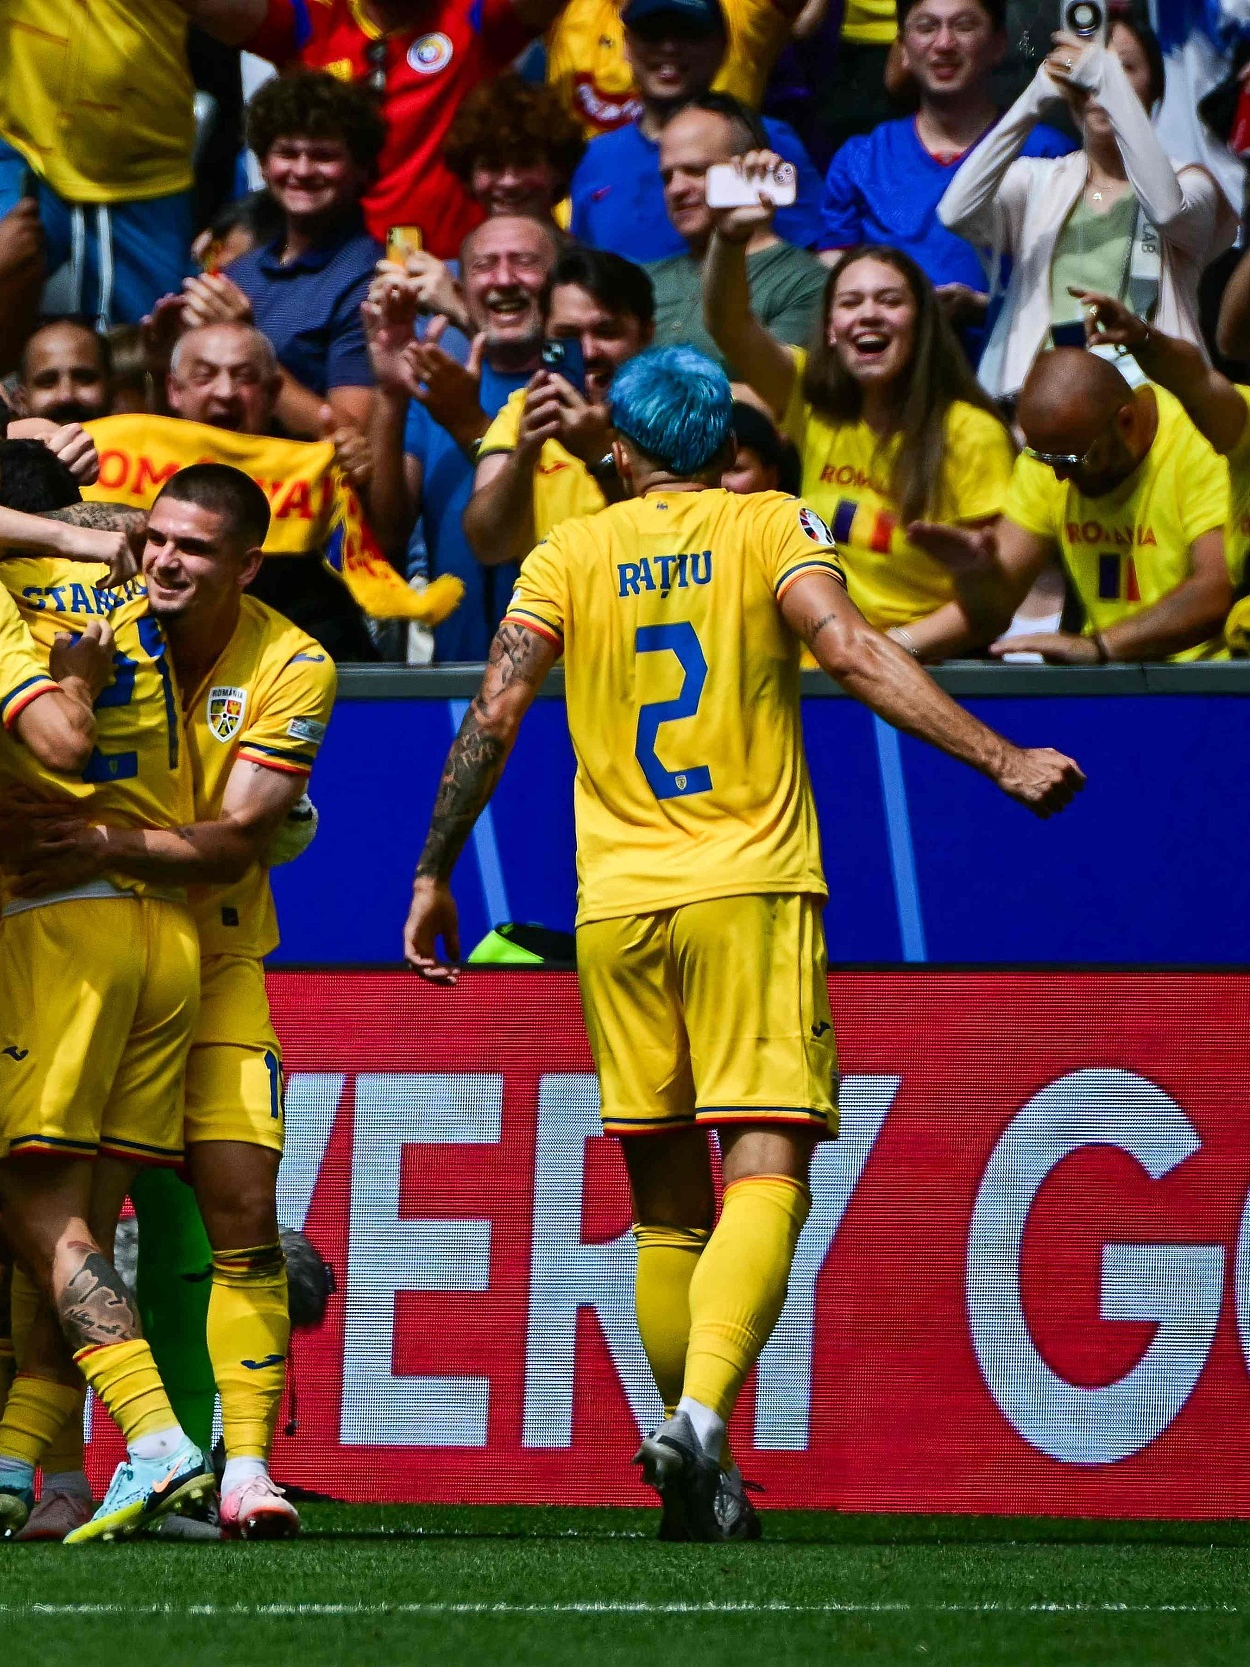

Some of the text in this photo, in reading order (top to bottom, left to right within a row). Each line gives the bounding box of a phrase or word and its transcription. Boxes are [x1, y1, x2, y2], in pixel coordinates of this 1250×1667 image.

[616, 550, 712, 599] RAȚIU
[634, 620, 714, 801] 2
[965, 1067, 1250, 1466] G
